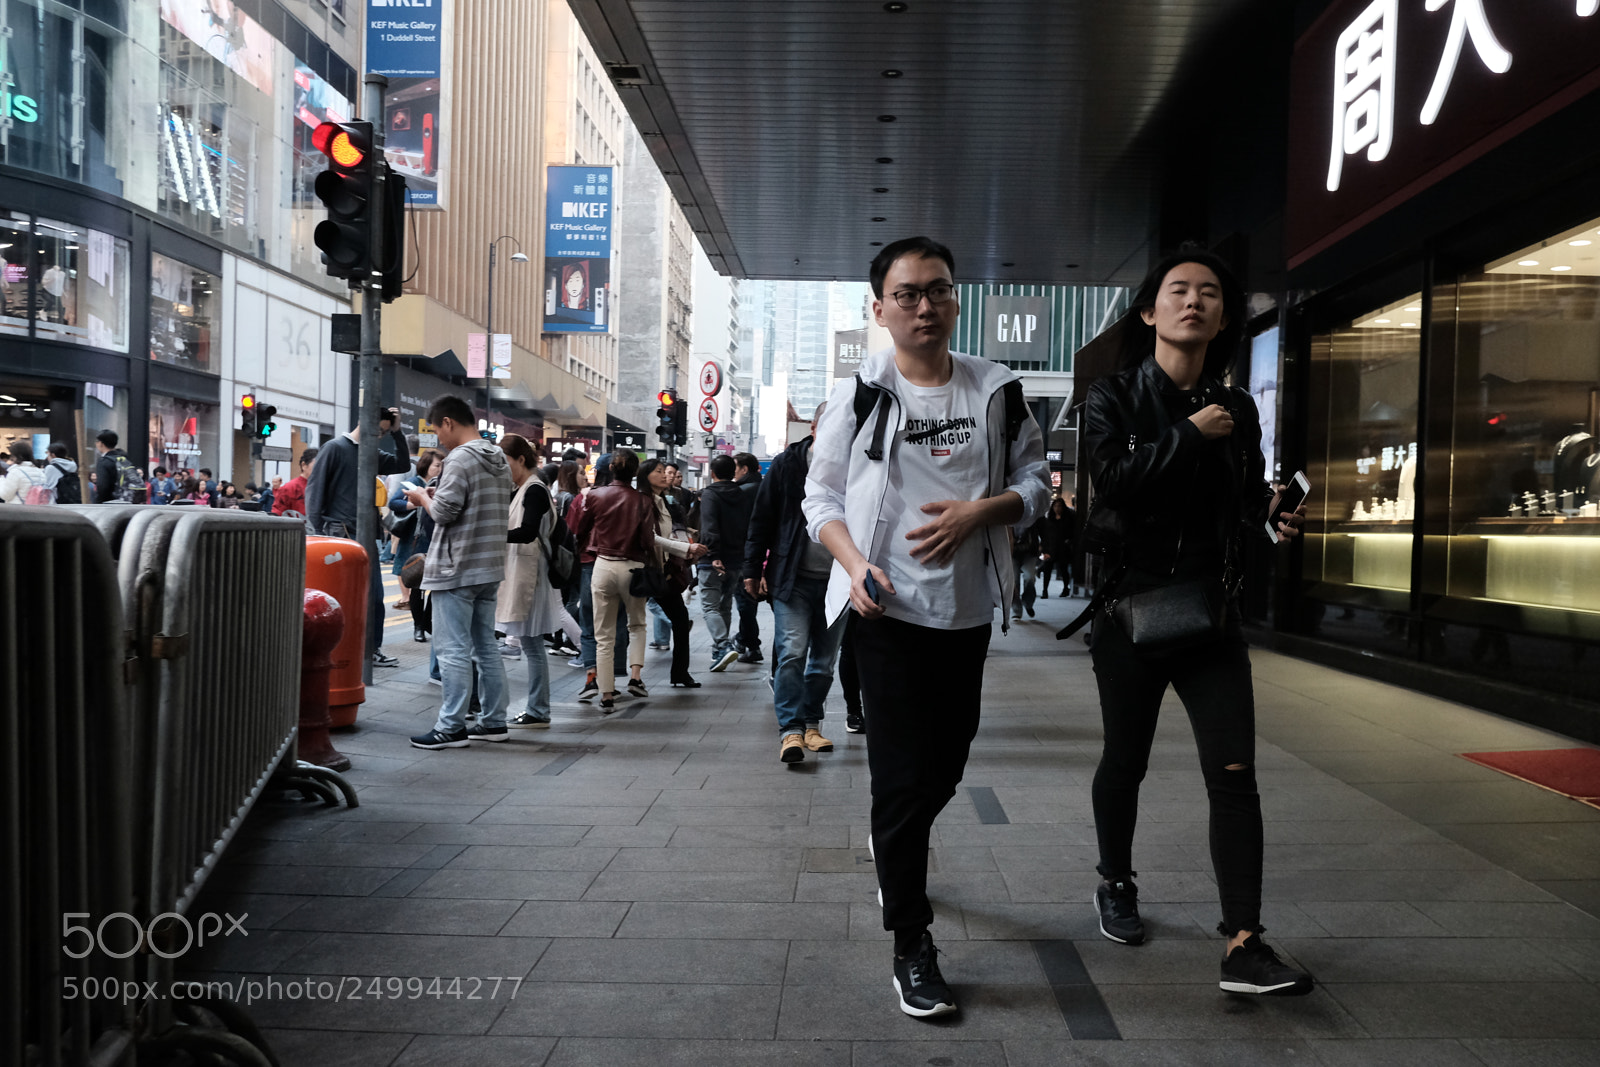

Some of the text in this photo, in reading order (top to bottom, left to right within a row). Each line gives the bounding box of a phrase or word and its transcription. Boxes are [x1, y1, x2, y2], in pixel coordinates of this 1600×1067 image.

[371, 21, 436, 31] KEF Music Gallery
[386, 34, 413, 42] Duddell
[414, 34, 436, 42] Street
[1326, 0, 1600, 192] 周大
[586, 174, 608, 184] 音樂
[578, 202, 608, 218] KEF
[564, 223, 583, 231] Music
[584, 223, 607, 232] Gallery
[997, 314, 1037, 343] GAP
[904, 418, 944, 432] OTHING
[957, 431, 971, 445] UP
